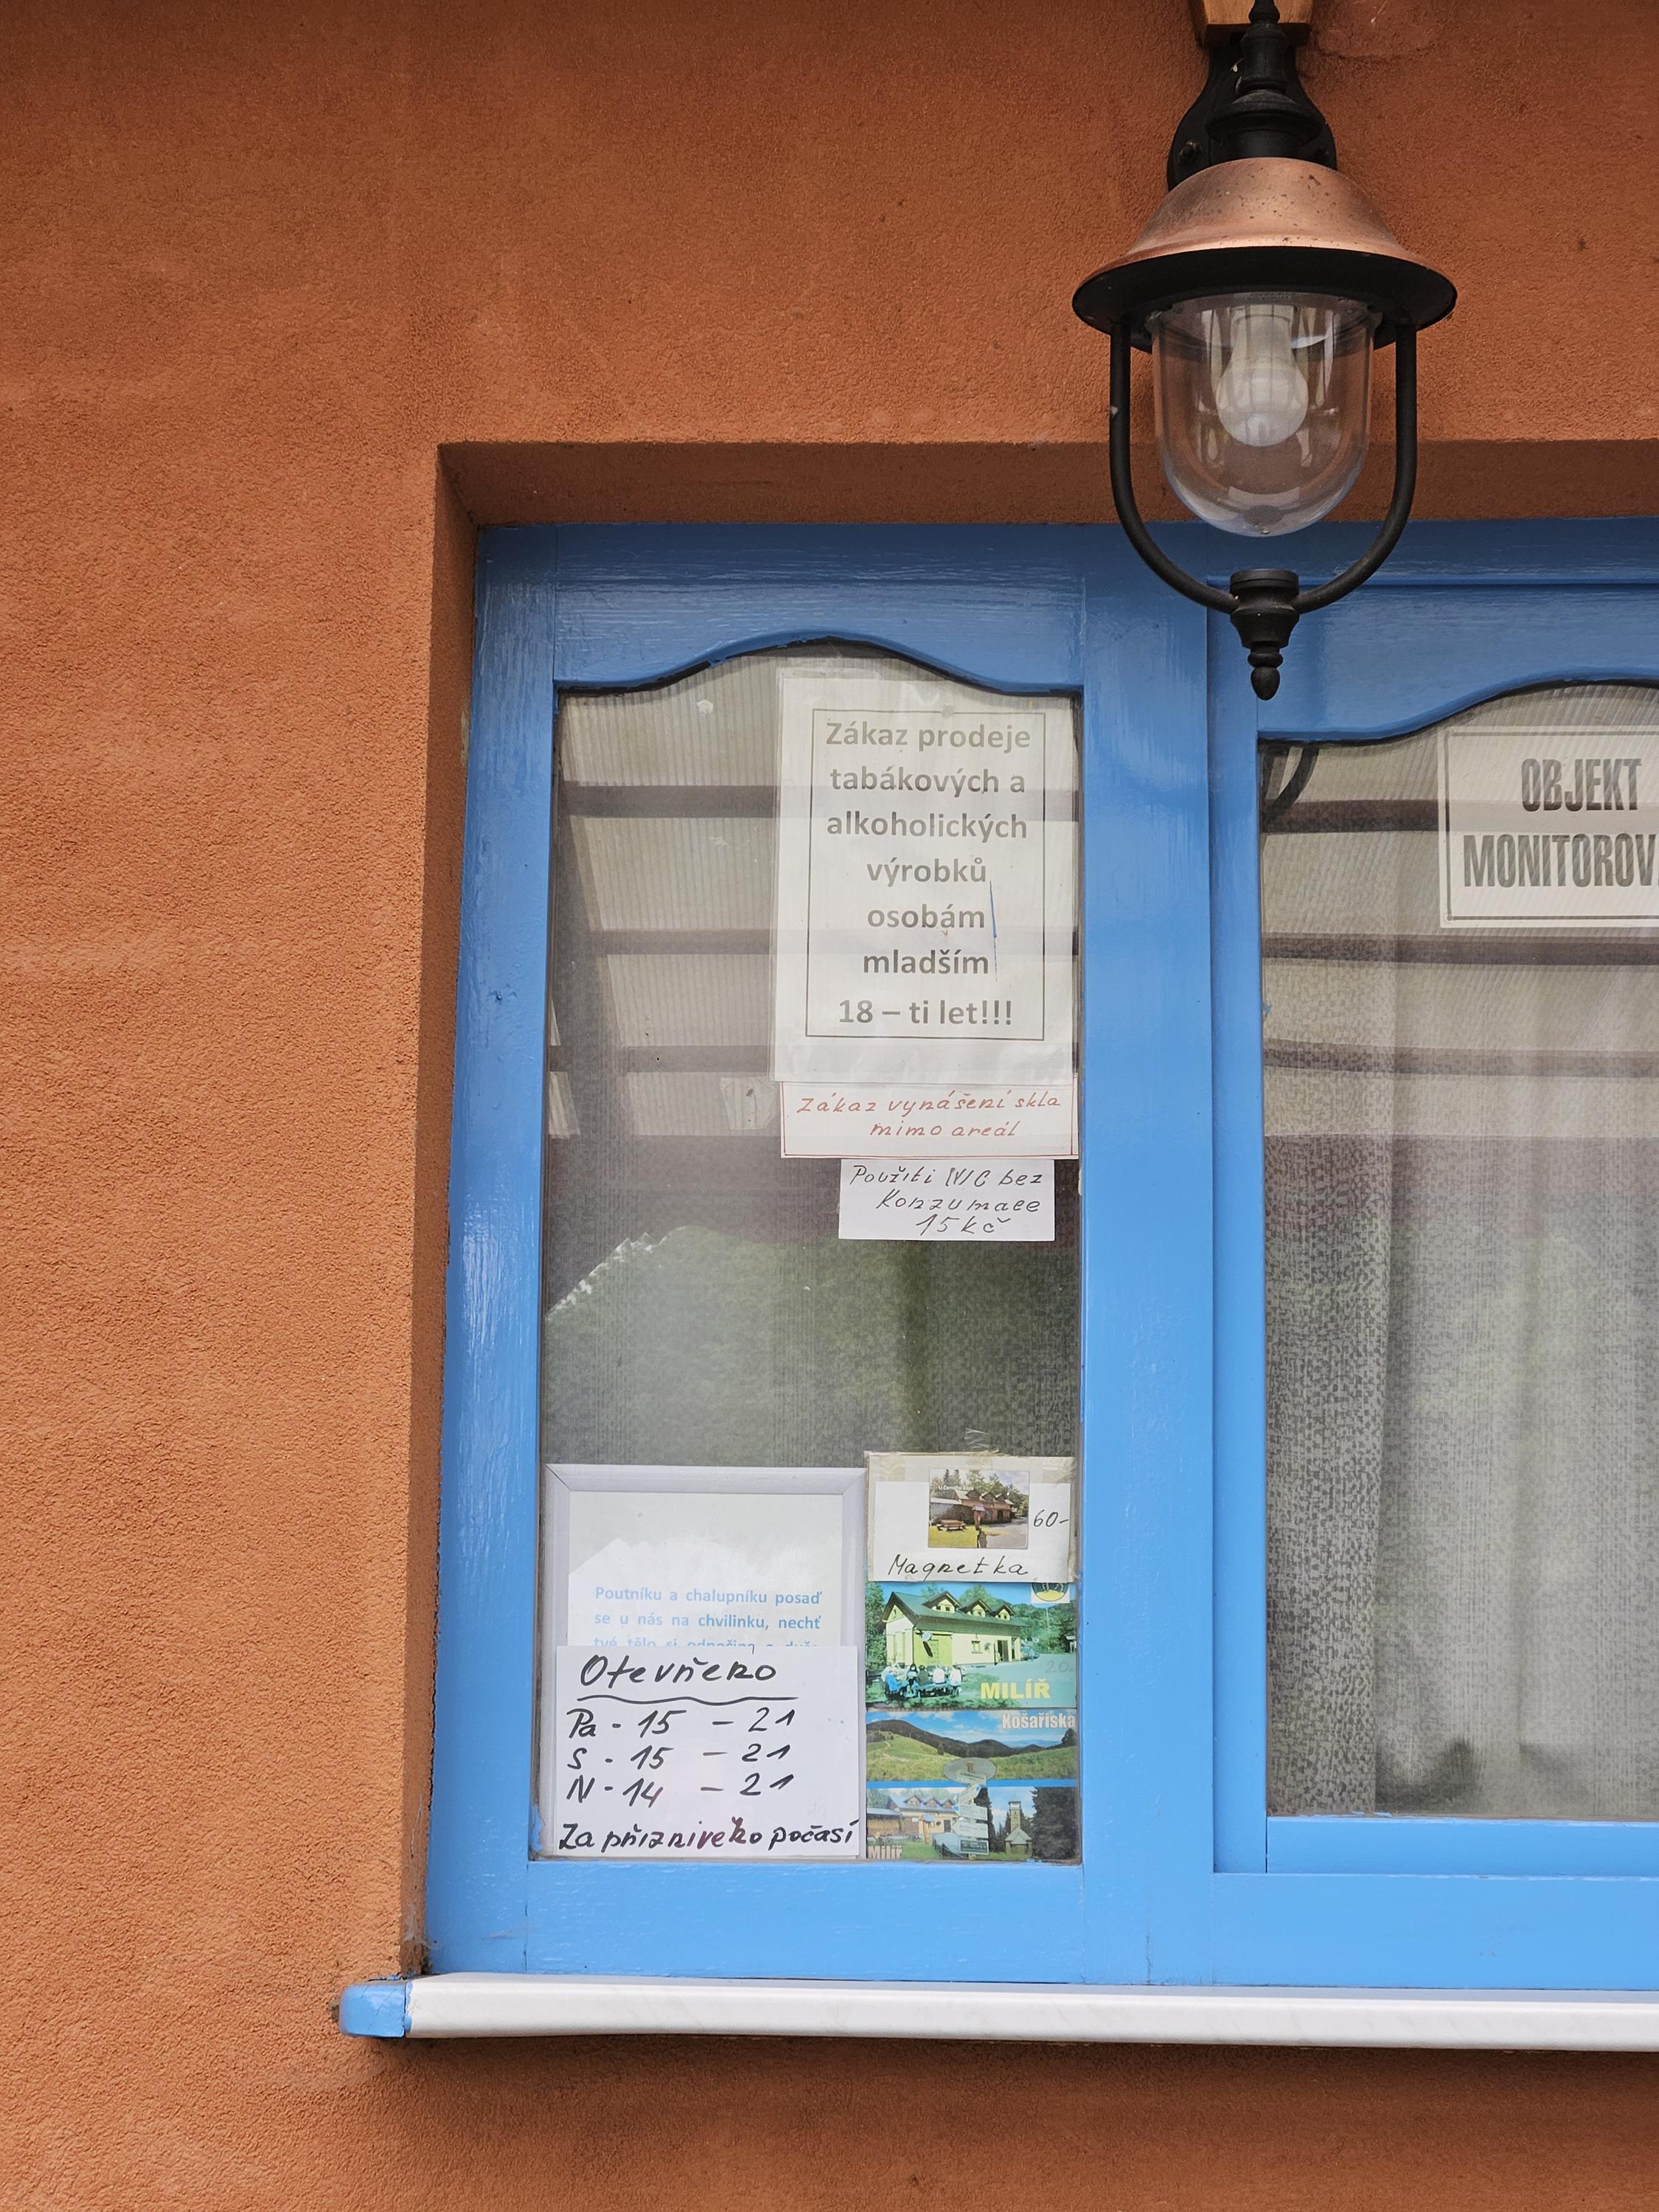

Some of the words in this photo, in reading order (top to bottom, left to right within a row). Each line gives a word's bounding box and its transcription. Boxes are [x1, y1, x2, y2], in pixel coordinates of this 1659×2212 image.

[826, 720, 908, 746] Zákaz
[918, 724, 1031, 754] prodeje
[830, 765, 999, 798] tabákových
[1009, 775, 1026, 793] a
[1520, 757, 1642, 812] OBJEKT
[827, 810, 1027, 844] alkoholických
[866, 857, 987, 887] výrobků
[1463, 833, 1659, 888] MONITOROV
[867, 903, 985, 929] osobám
[863, 949, 989, 974] mladším
[838, 999, 874, 1023] 18
[909, 1000, 929, 1024] ti
[939, 1000, 1013, 1025] let!!!
[1015, 1091, 1062, 1109] skla
[869, 1120, 944, 1137] mimo
[951, 1120, 1020, 1137] areál
[945, 1167, 991, 1187] WC
[998, 1169, 1043, 1187] bez
[888, 1554, 1029, 1582] Magnetka
[595, 1587, 661, 1601] Poutníku
[669, 1591, 678, 1601] a
[686, 1588, 767, 1605] chalupníku
[775, 1591, 823, 1606] posaď
[594, 1614, 611, 1624] se
[620, 1615, 628, 1625] u
[637, 1612, 663, 1626] nás
[672, 1615, 689, 1627] na
[698, 1614, 769, 1630] chvilinku,
[779, 1615, 821, 1630] nechť
[980, 1678, 1051, 1700] MILÍŘ
[638, 1709, 687, 1739] 15
[748, 1707, 796, 1733] 21
[1002, 1712, 1077, 1729] Košařiska
[567, 1747, 588, 1771] S
[630, 1745, 675, 1770] 15
[741, 1743, 791, 1763] 21
[566, 1774, 595, 1804] N
[622, 1778, 664, 1809] 14
[740, 1773, 794, 1797] 21
